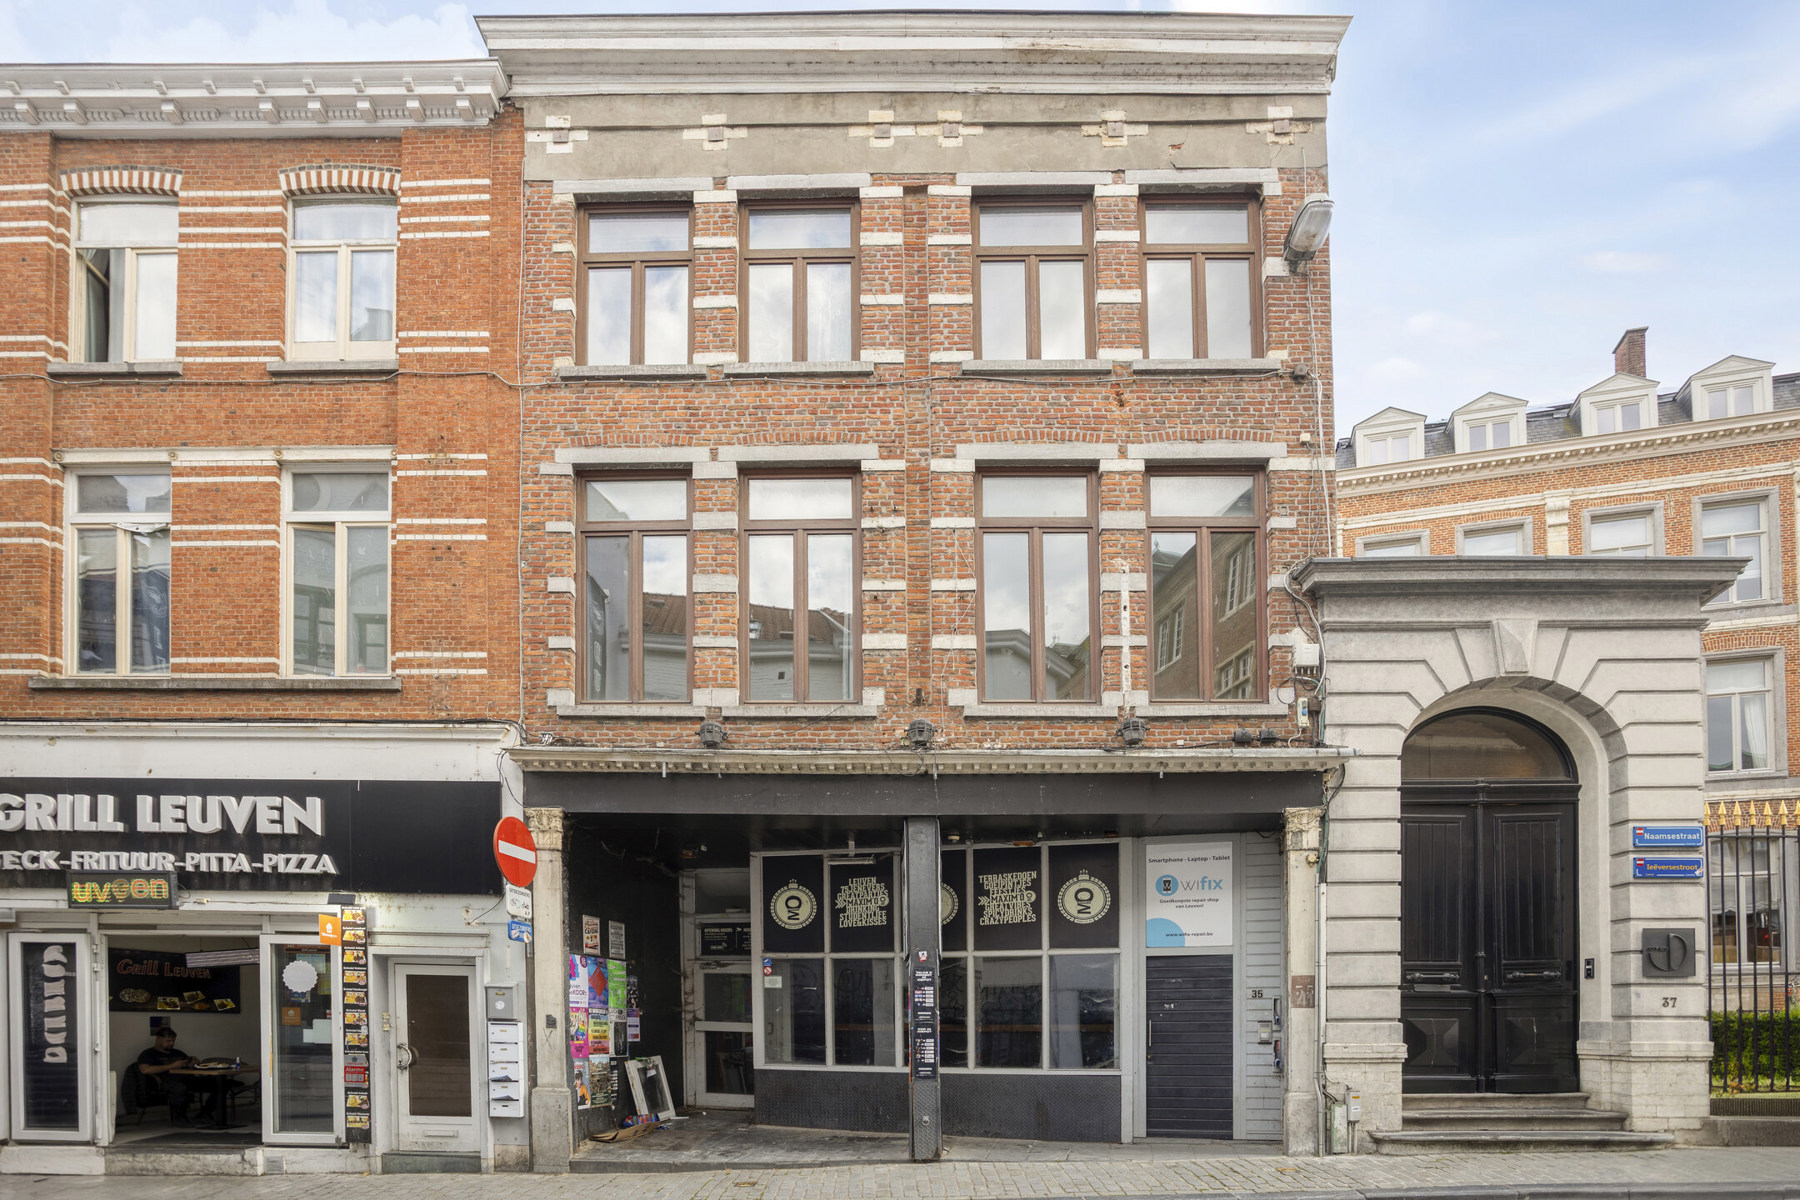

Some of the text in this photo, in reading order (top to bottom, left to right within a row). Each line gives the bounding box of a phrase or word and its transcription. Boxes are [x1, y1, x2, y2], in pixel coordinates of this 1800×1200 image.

[0, 793, 321, 836] GRILL LEUVEN
[848, 876, 877, 886] LEUVEN
[1251, 989, 1264, 999] 35
[1662, 997, 1677, 1008] 37
